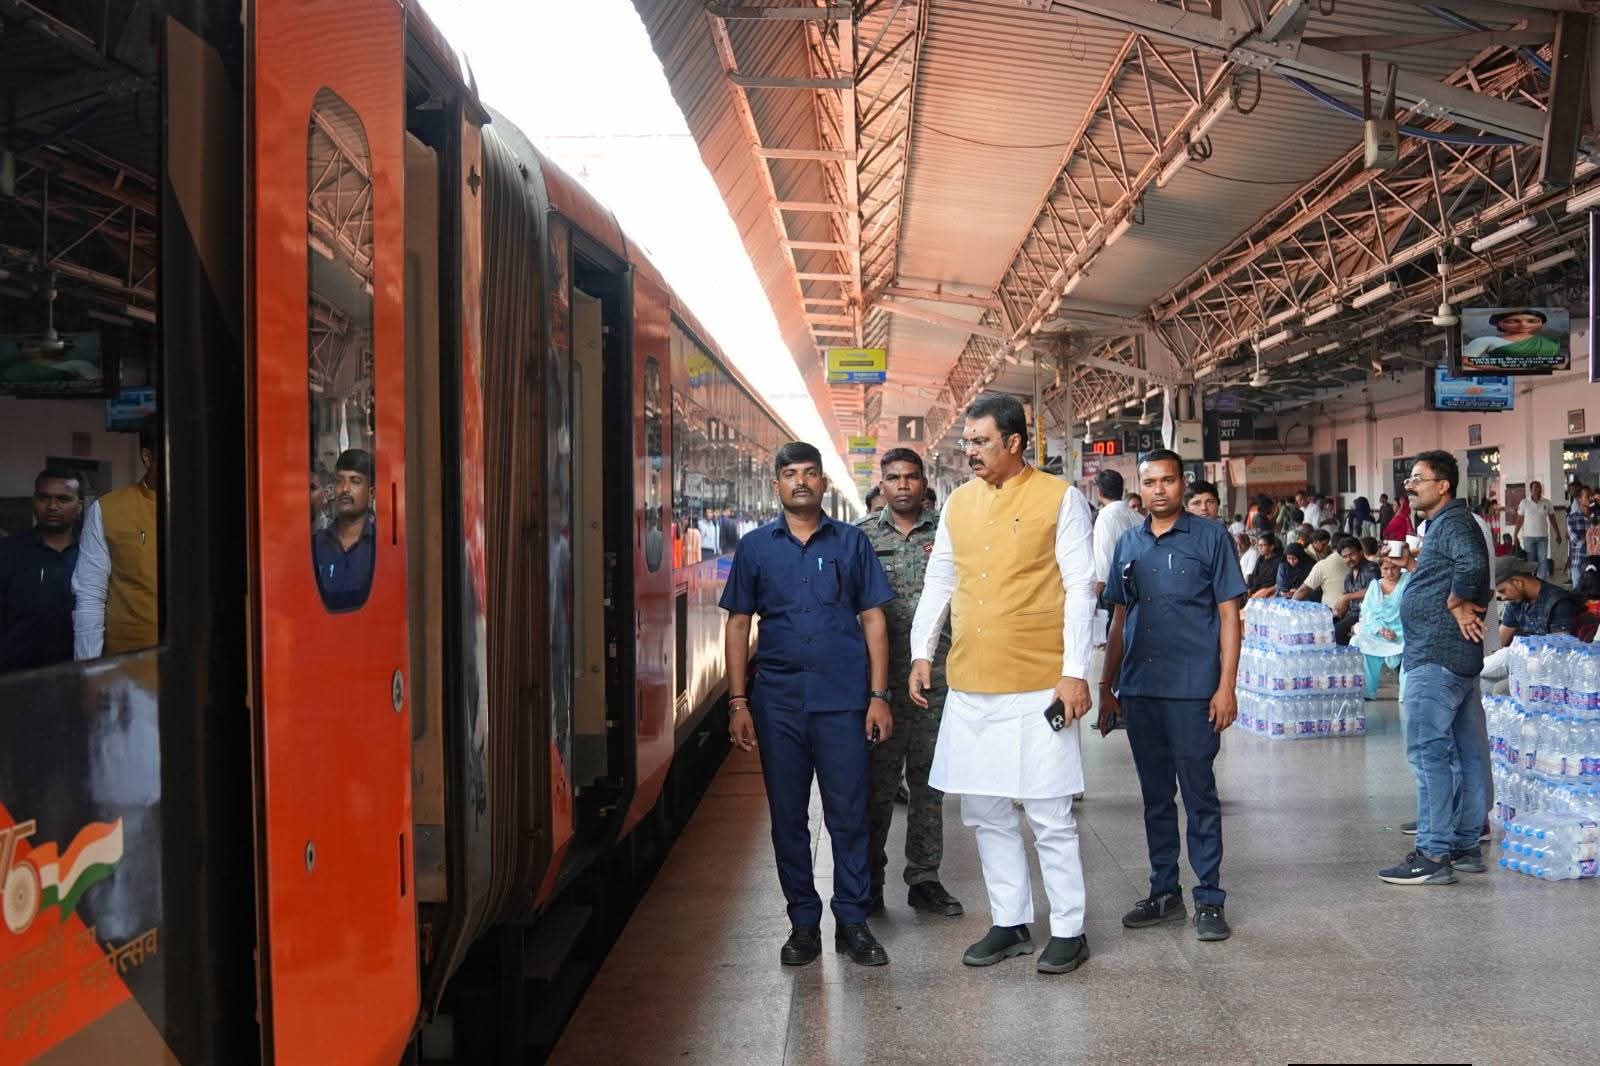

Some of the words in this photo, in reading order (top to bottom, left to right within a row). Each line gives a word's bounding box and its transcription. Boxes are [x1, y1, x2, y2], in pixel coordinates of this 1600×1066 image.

[906, 419, 916, 439] 1
[1218, 418, 1241, 428] कास
[1220, 428, 1237, 438] XIT
[1141, 434, 1151, 449] 3
